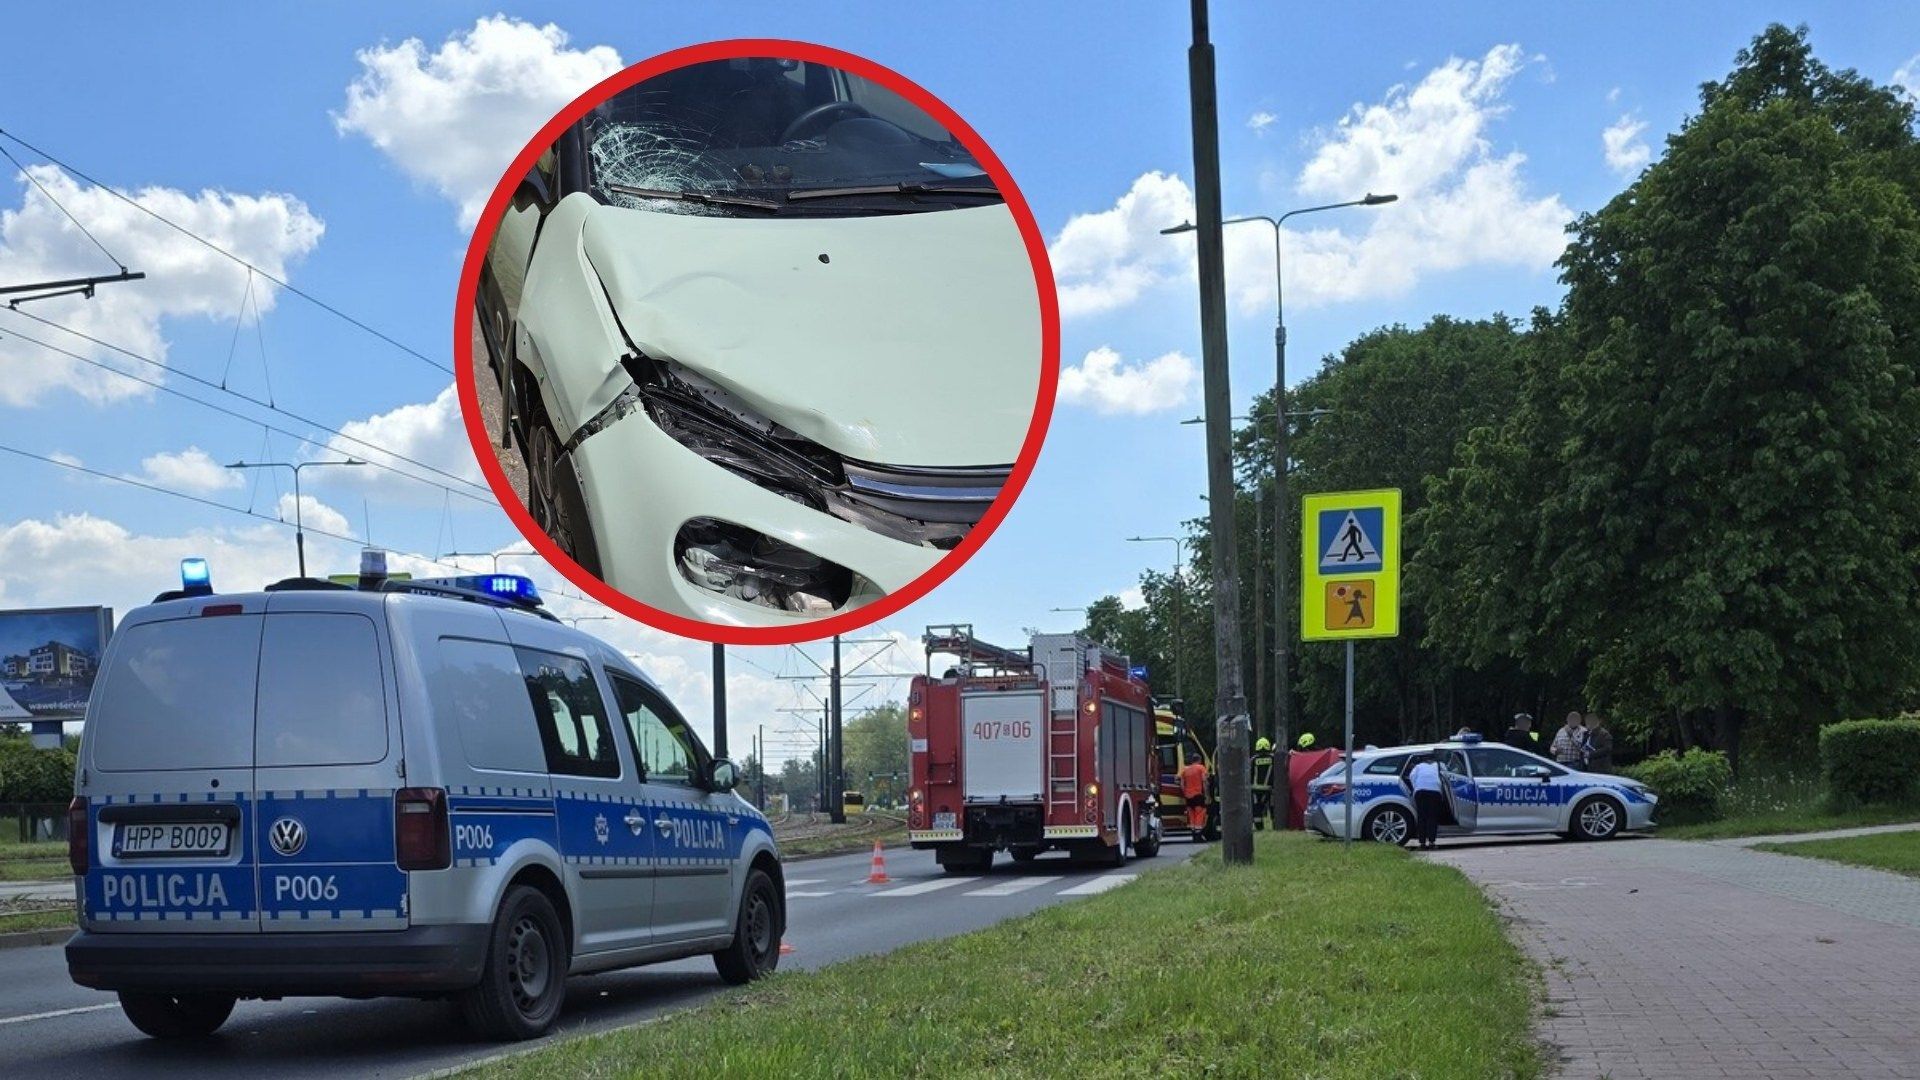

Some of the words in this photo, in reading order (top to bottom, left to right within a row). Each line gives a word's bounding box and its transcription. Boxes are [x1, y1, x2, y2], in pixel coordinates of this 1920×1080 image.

[1496, 788, 1548, 801] POLICJA
[126, 827, 164, 850] HPP
[170, 826, 222, 849] B009
[455, 824, 494, 850] P006
[673, 817, 725, 850] POLICJA
[102, 872, 229, 908] POLICJA
[275, 875, 339, 901] P006
